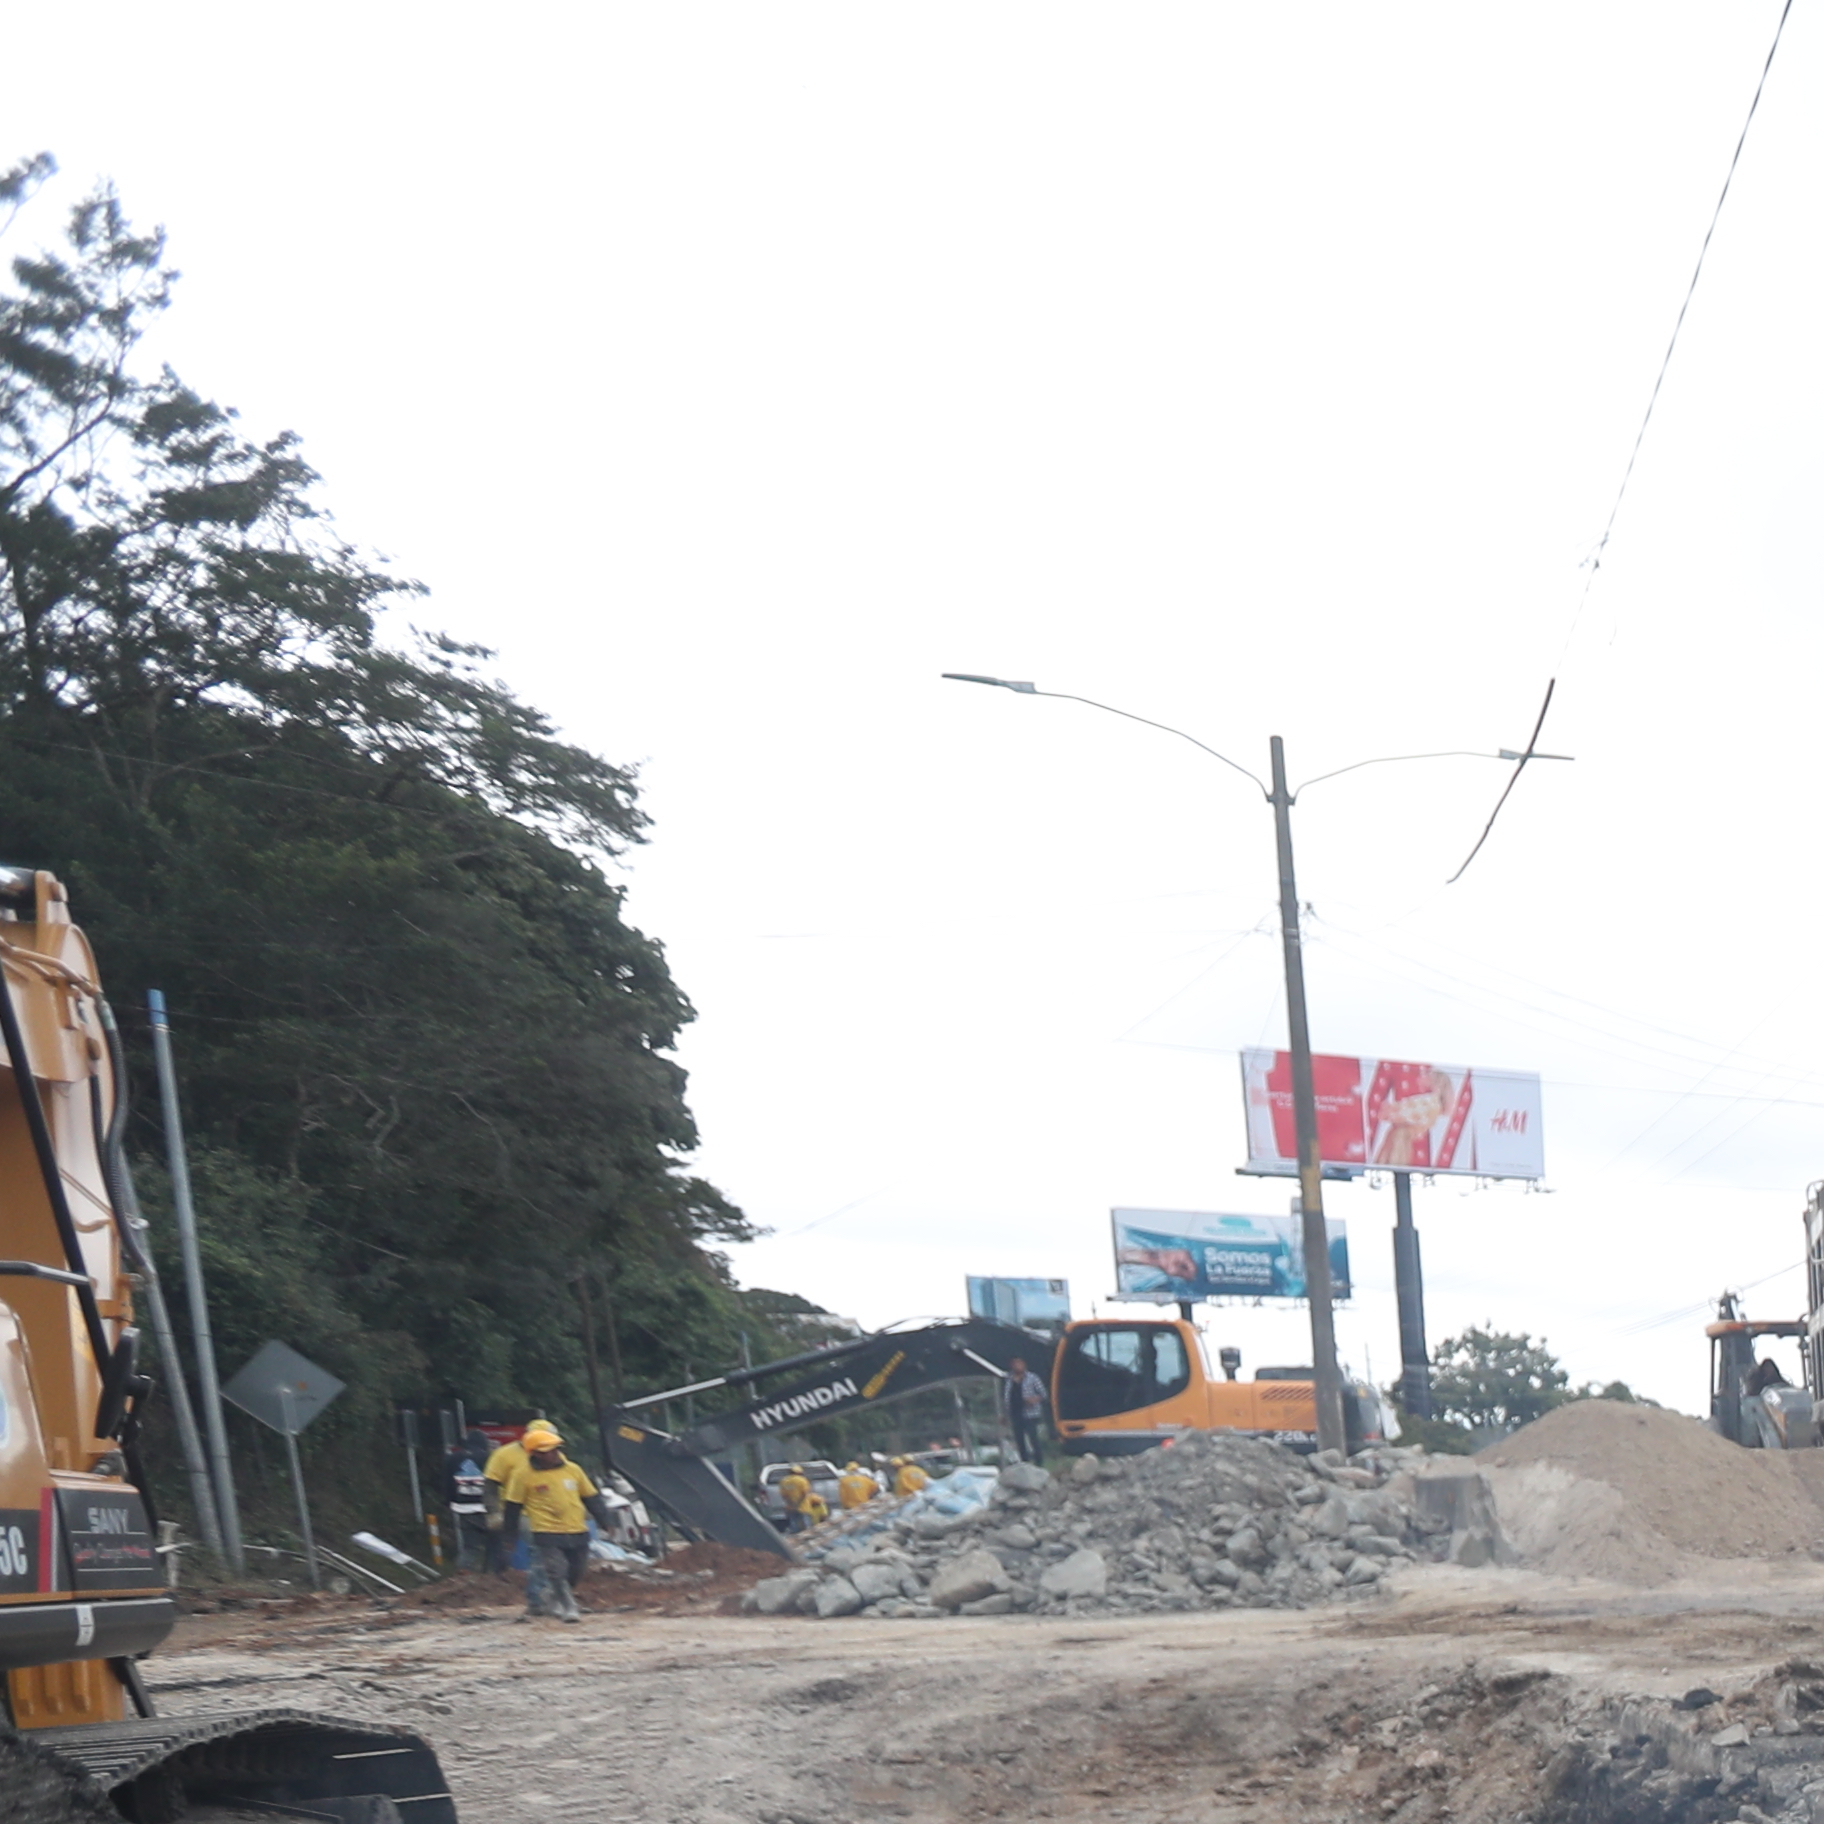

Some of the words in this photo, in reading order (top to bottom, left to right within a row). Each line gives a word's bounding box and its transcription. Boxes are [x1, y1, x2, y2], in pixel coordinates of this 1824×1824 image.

[1204, 1247, 1271, 1264] Somos
[750, 1377, 859, 1430] HYUNDAI
[87, 1507, 129, 1534] SANY
